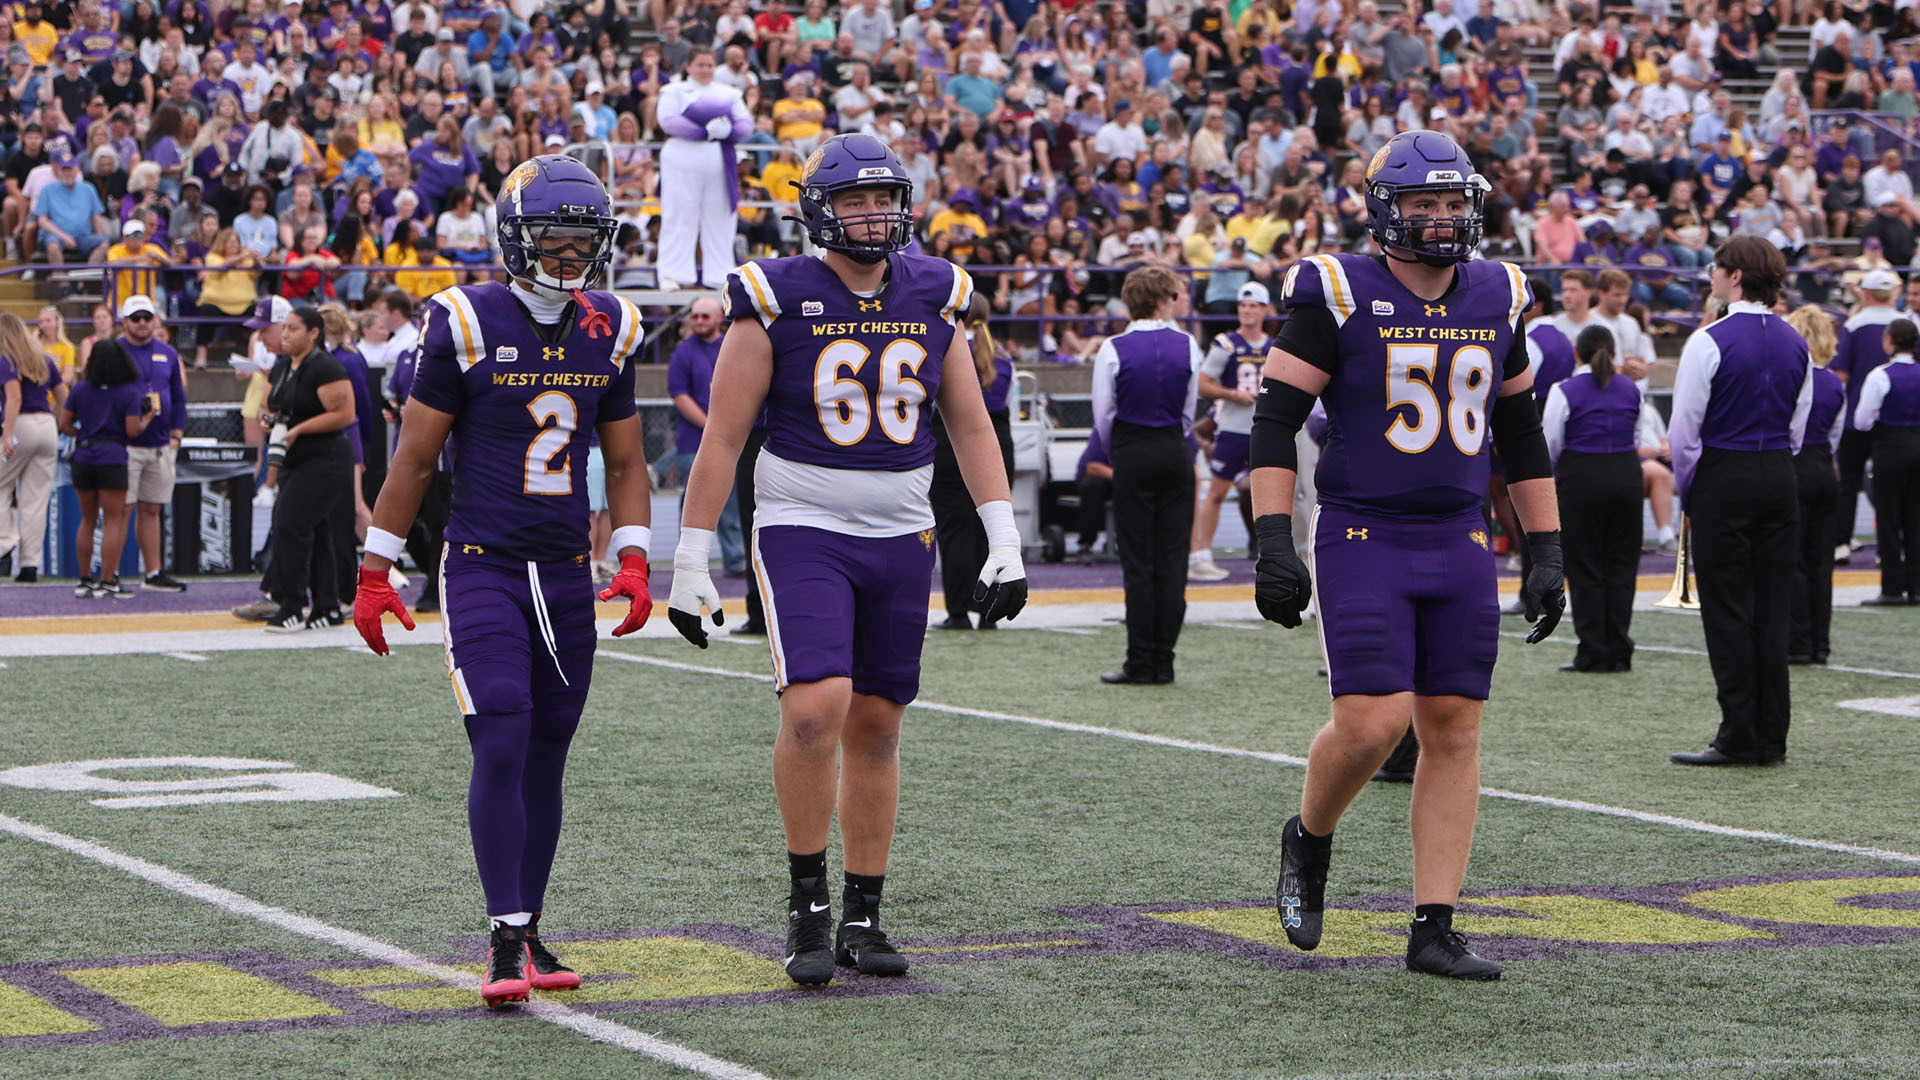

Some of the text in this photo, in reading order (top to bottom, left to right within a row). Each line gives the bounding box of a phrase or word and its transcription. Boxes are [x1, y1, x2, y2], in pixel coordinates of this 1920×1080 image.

[811, 321, 928, 336] WEST CHESTER
[1378, 327, 1497, 341] WEST CHESTER
[492, 372, 609, 387] WEST CHESTER
[814, 338, 928, 446] 66
[1384, 343, 1494, 456] 58
[220, 449, 246, 461] ONLY
[523, 390, 578, 496] 2
[200, 482, 225, 571] WCU
[0, 756, 406, 810] 5
